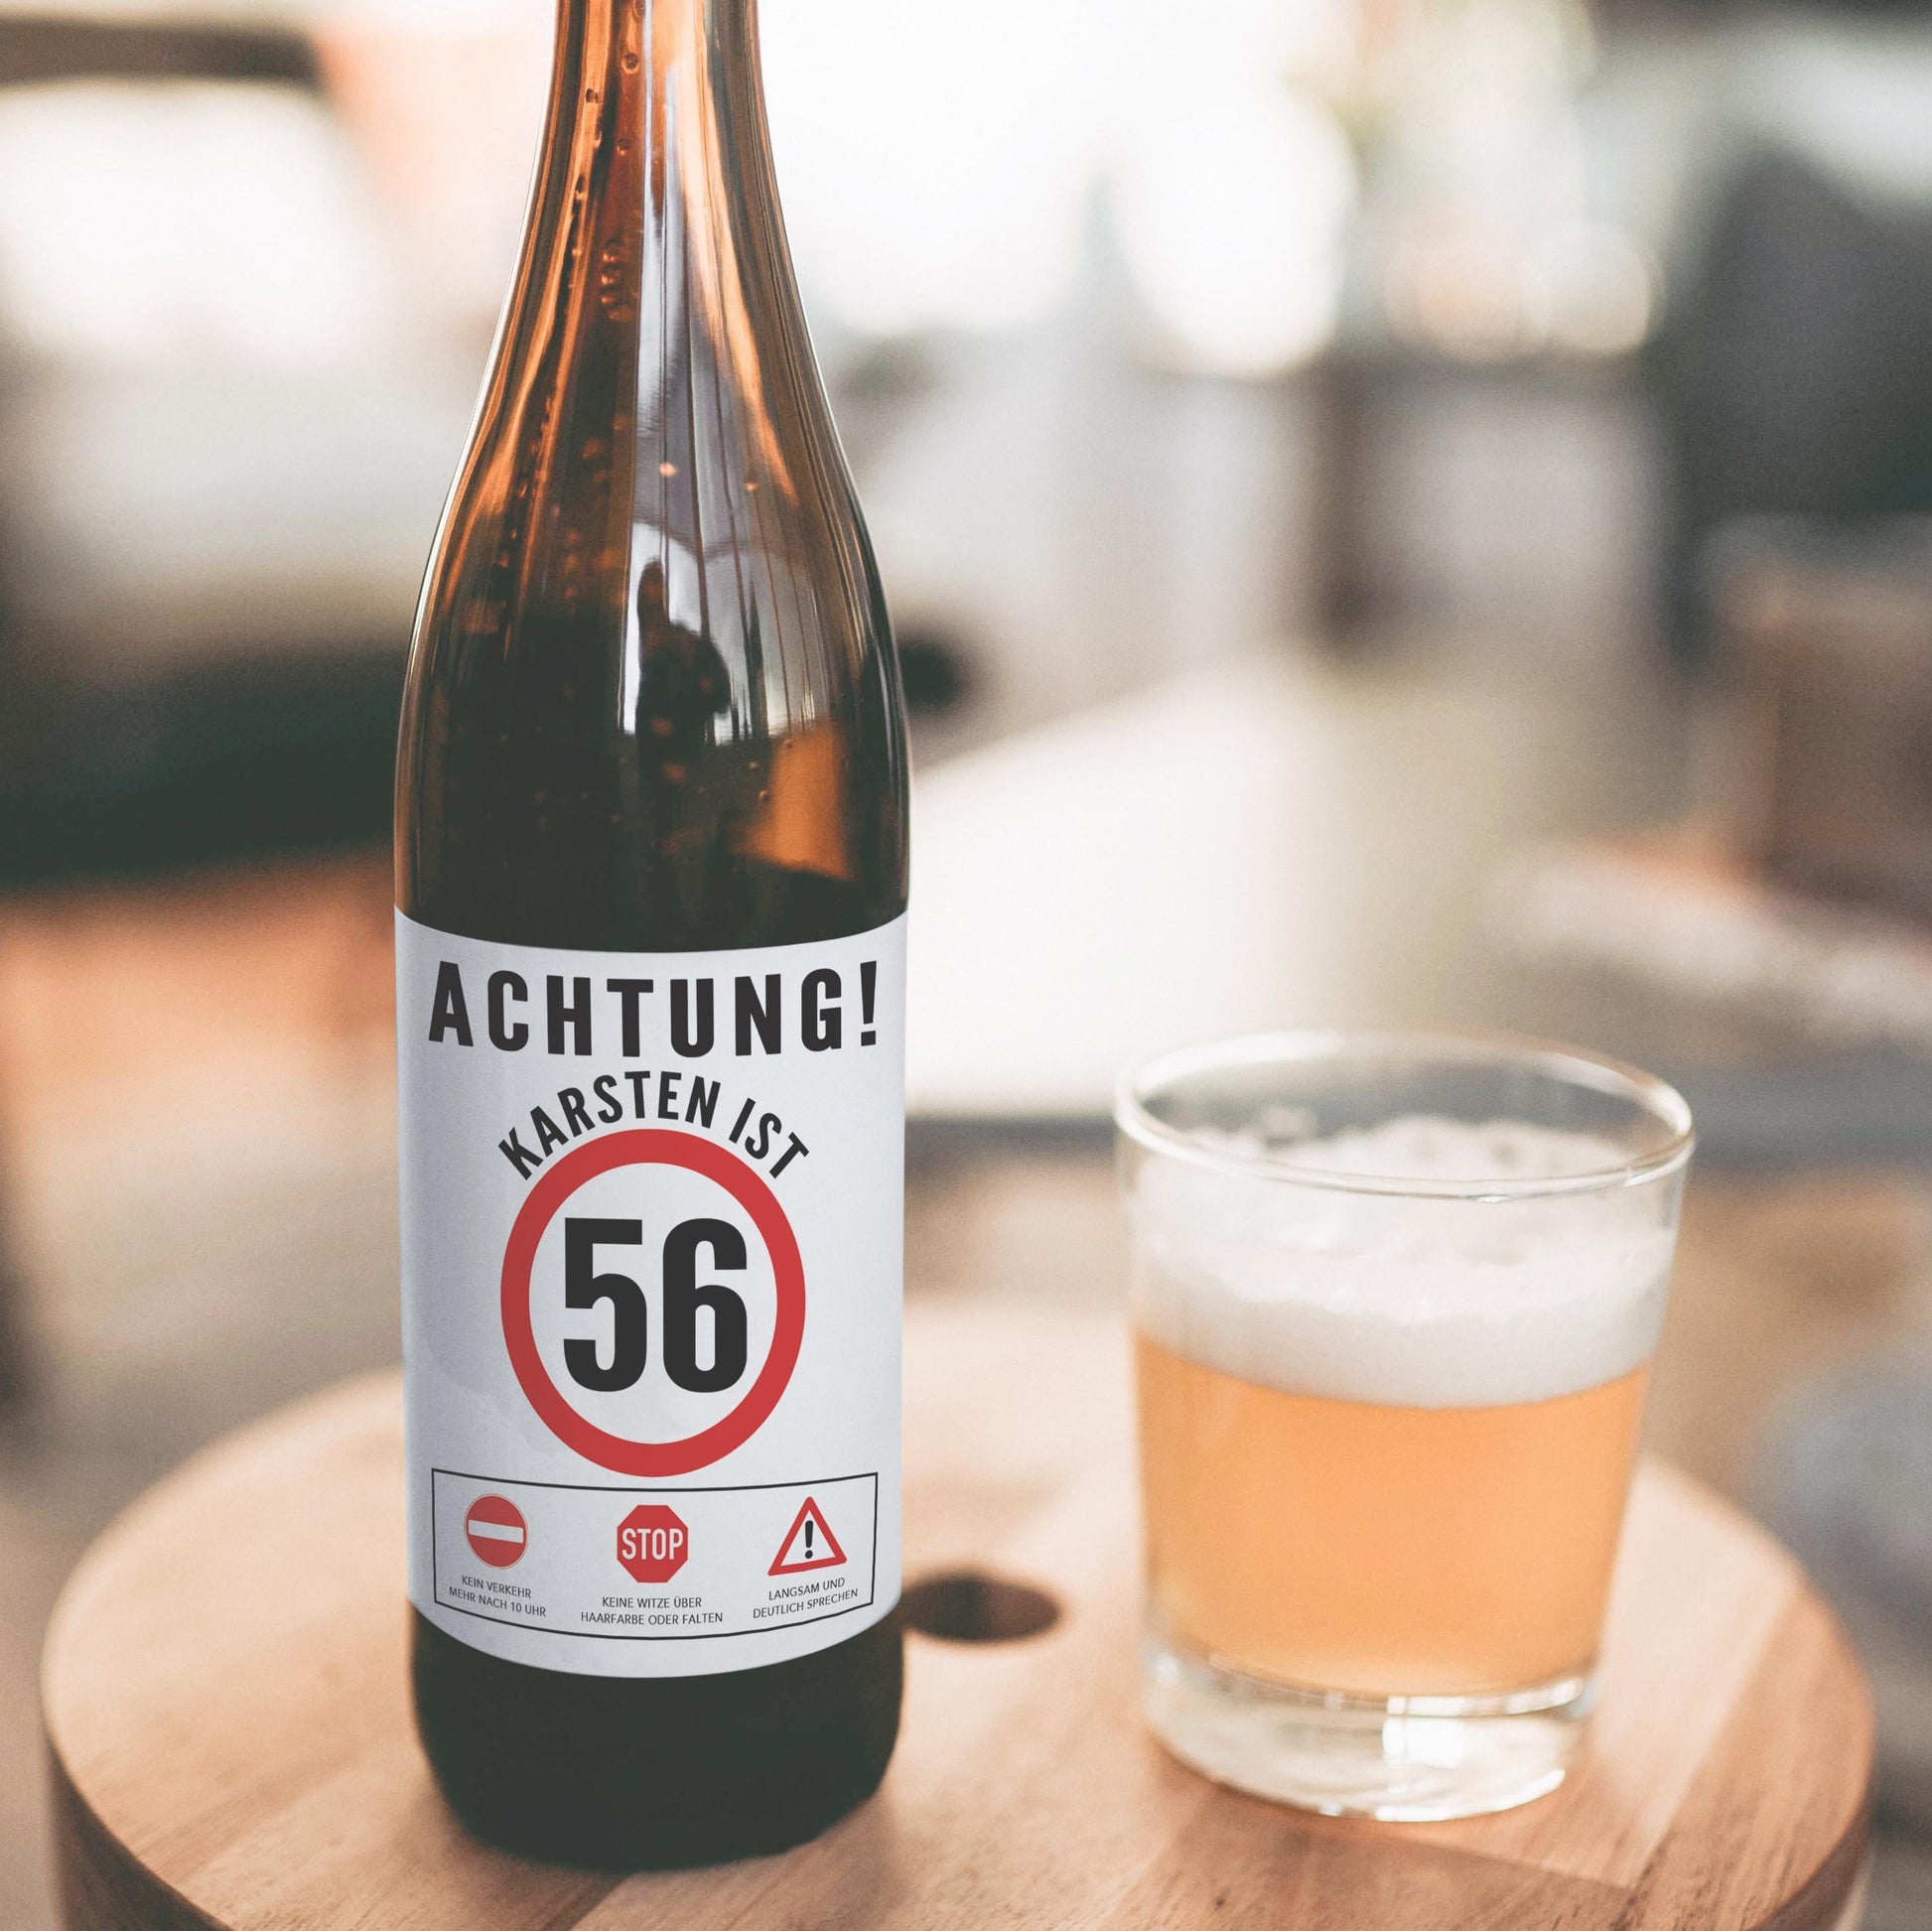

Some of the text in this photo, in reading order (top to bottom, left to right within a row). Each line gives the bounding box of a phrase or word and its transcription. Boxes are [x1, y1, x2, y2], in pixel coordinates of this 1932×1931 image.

[428, 960, 878, 1058] ACHTUNG!
[497, 1070, 810, 1181] KARSTEN IST
[563, 1217, 748, 1394] 56
[621, 1527, 684, 1561] STOP
[449, 1586, 546, 1617] MEHR NACH 10 UHR
[462, 1575, 532, 1598] KEIN VERKEHR
[602, 1595, 702, 1609] KEINE WITZE ÜBER
[768, 1577, 846, 1601] LANGSAM UND
[581, 1611, 723, 1625] HAARFARBE ODER FALTEN
[753, 1588, 859, 1619] DEUTLICH SPRECHEN
